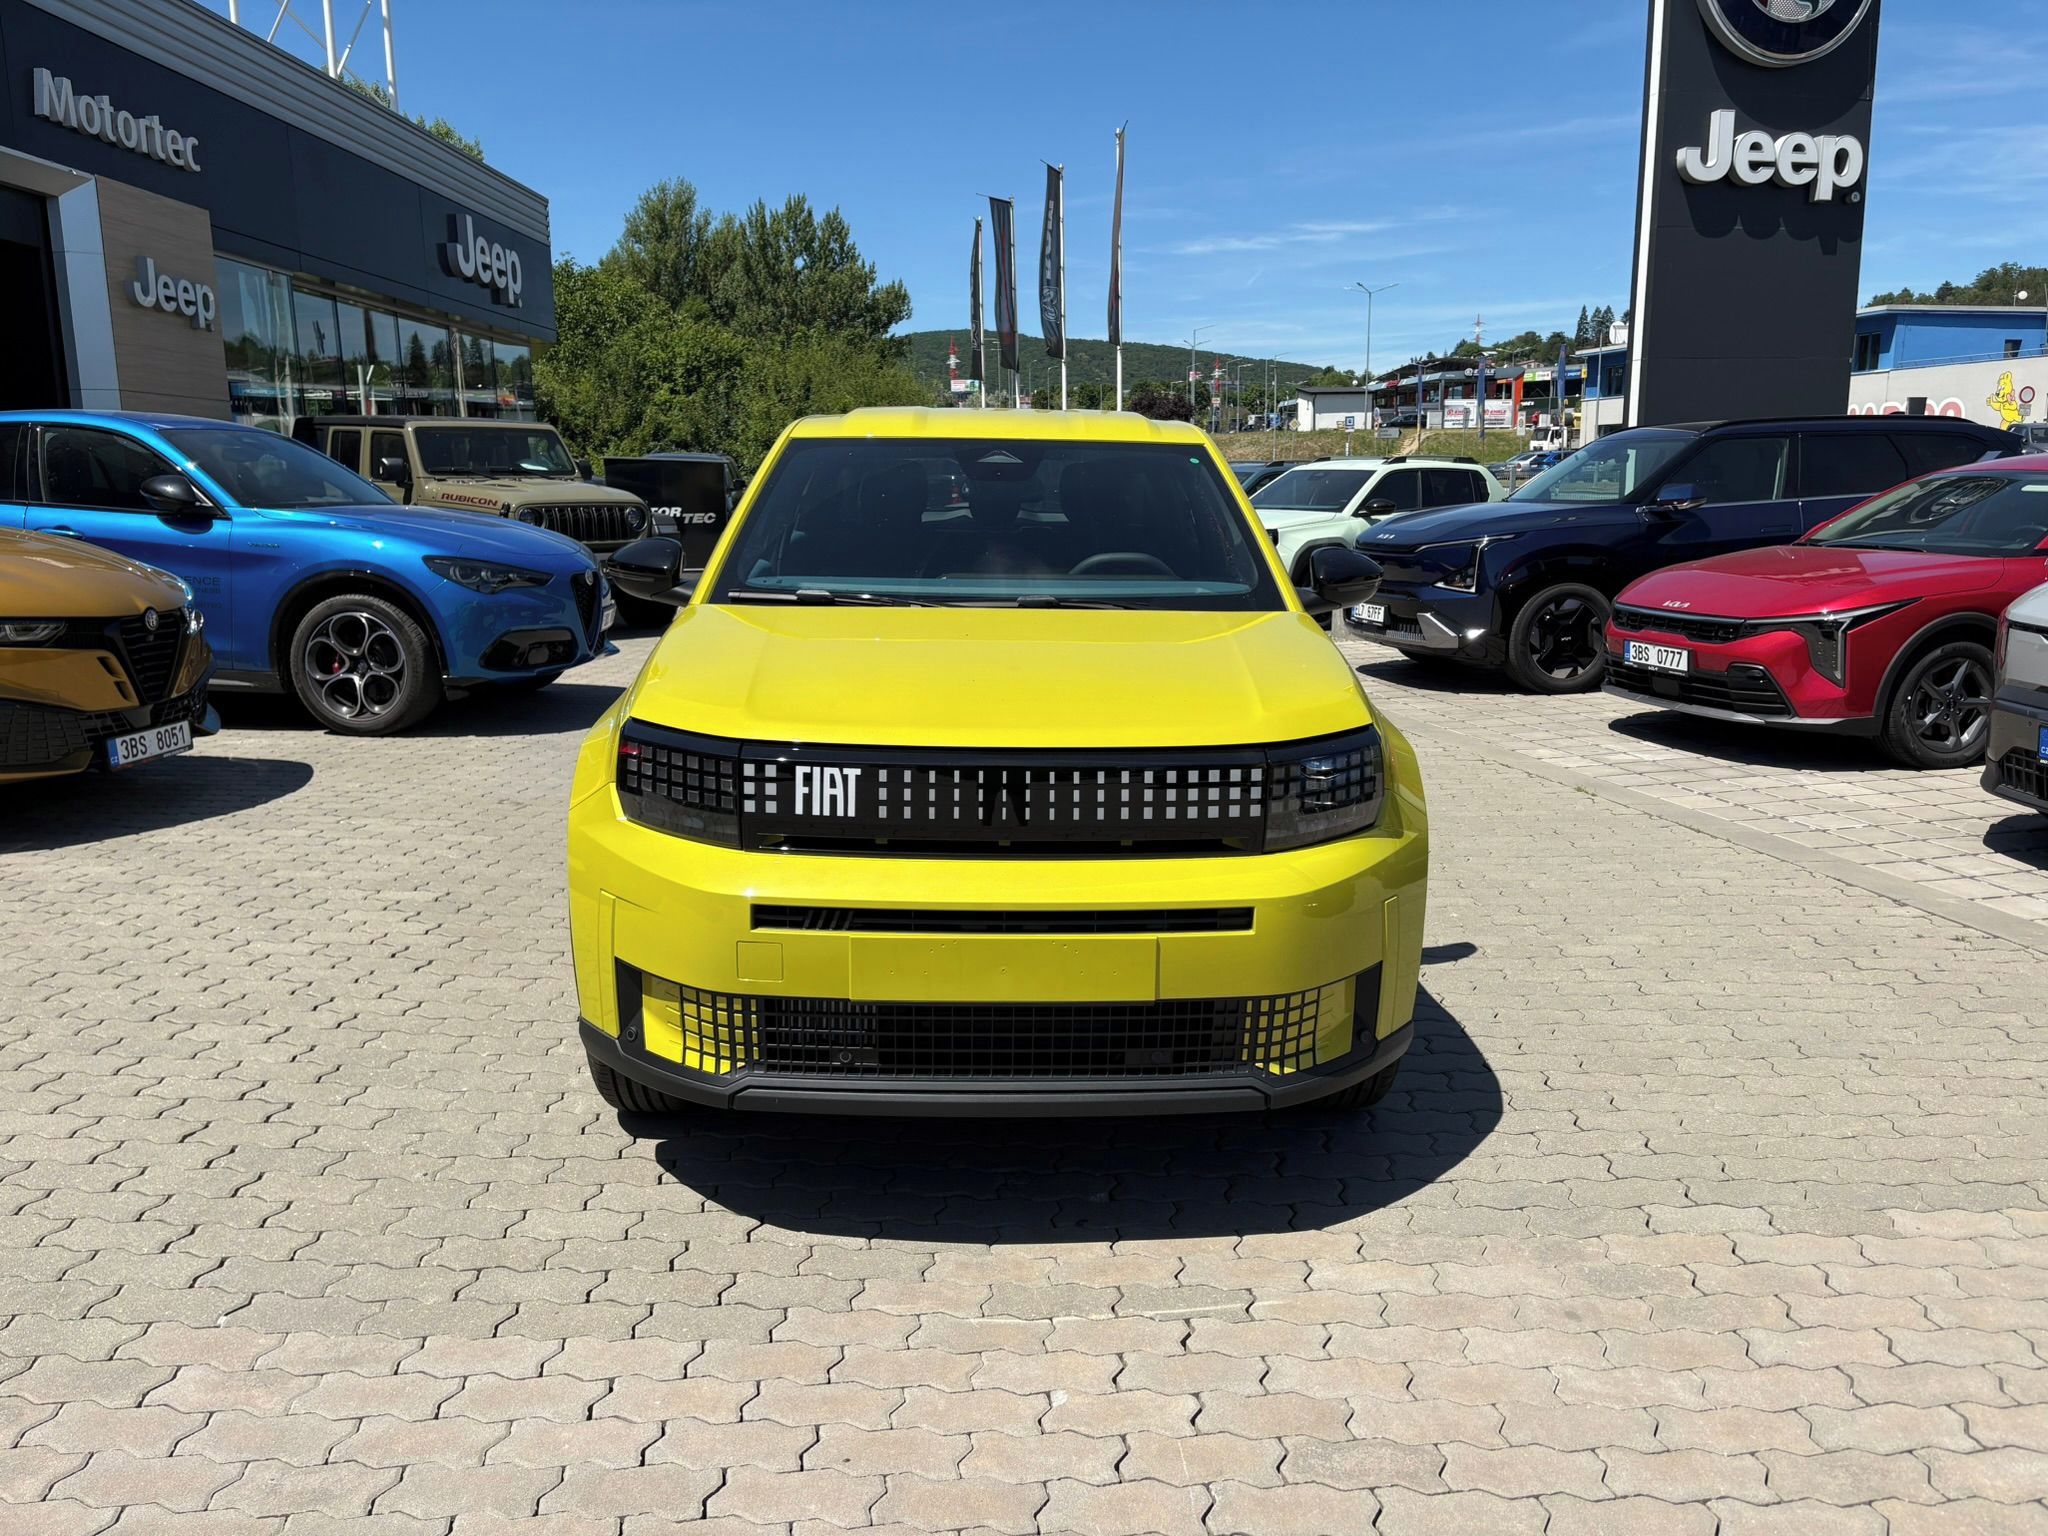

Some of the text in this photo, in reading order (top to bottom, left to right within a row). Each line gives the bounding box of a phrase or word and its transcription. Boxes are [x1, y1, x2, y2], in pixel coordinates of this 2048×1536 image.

[34, 67, 201, 172] Motortec
[1676, 108, 1864, 203] Jeep
[447, 213, 523, 306] Jeep
[131, 256, 216, 330] Jeep
[441, 492, 499, 507] RUBICON
[682, 513, 717, 524] TEC
[1631, 644, 1682, 668] 3BS 0777
[120, 735, 148, 760] 3BS
[156, 723, 187, 751] 8051
[794, 765, 862, 818] FIAT
